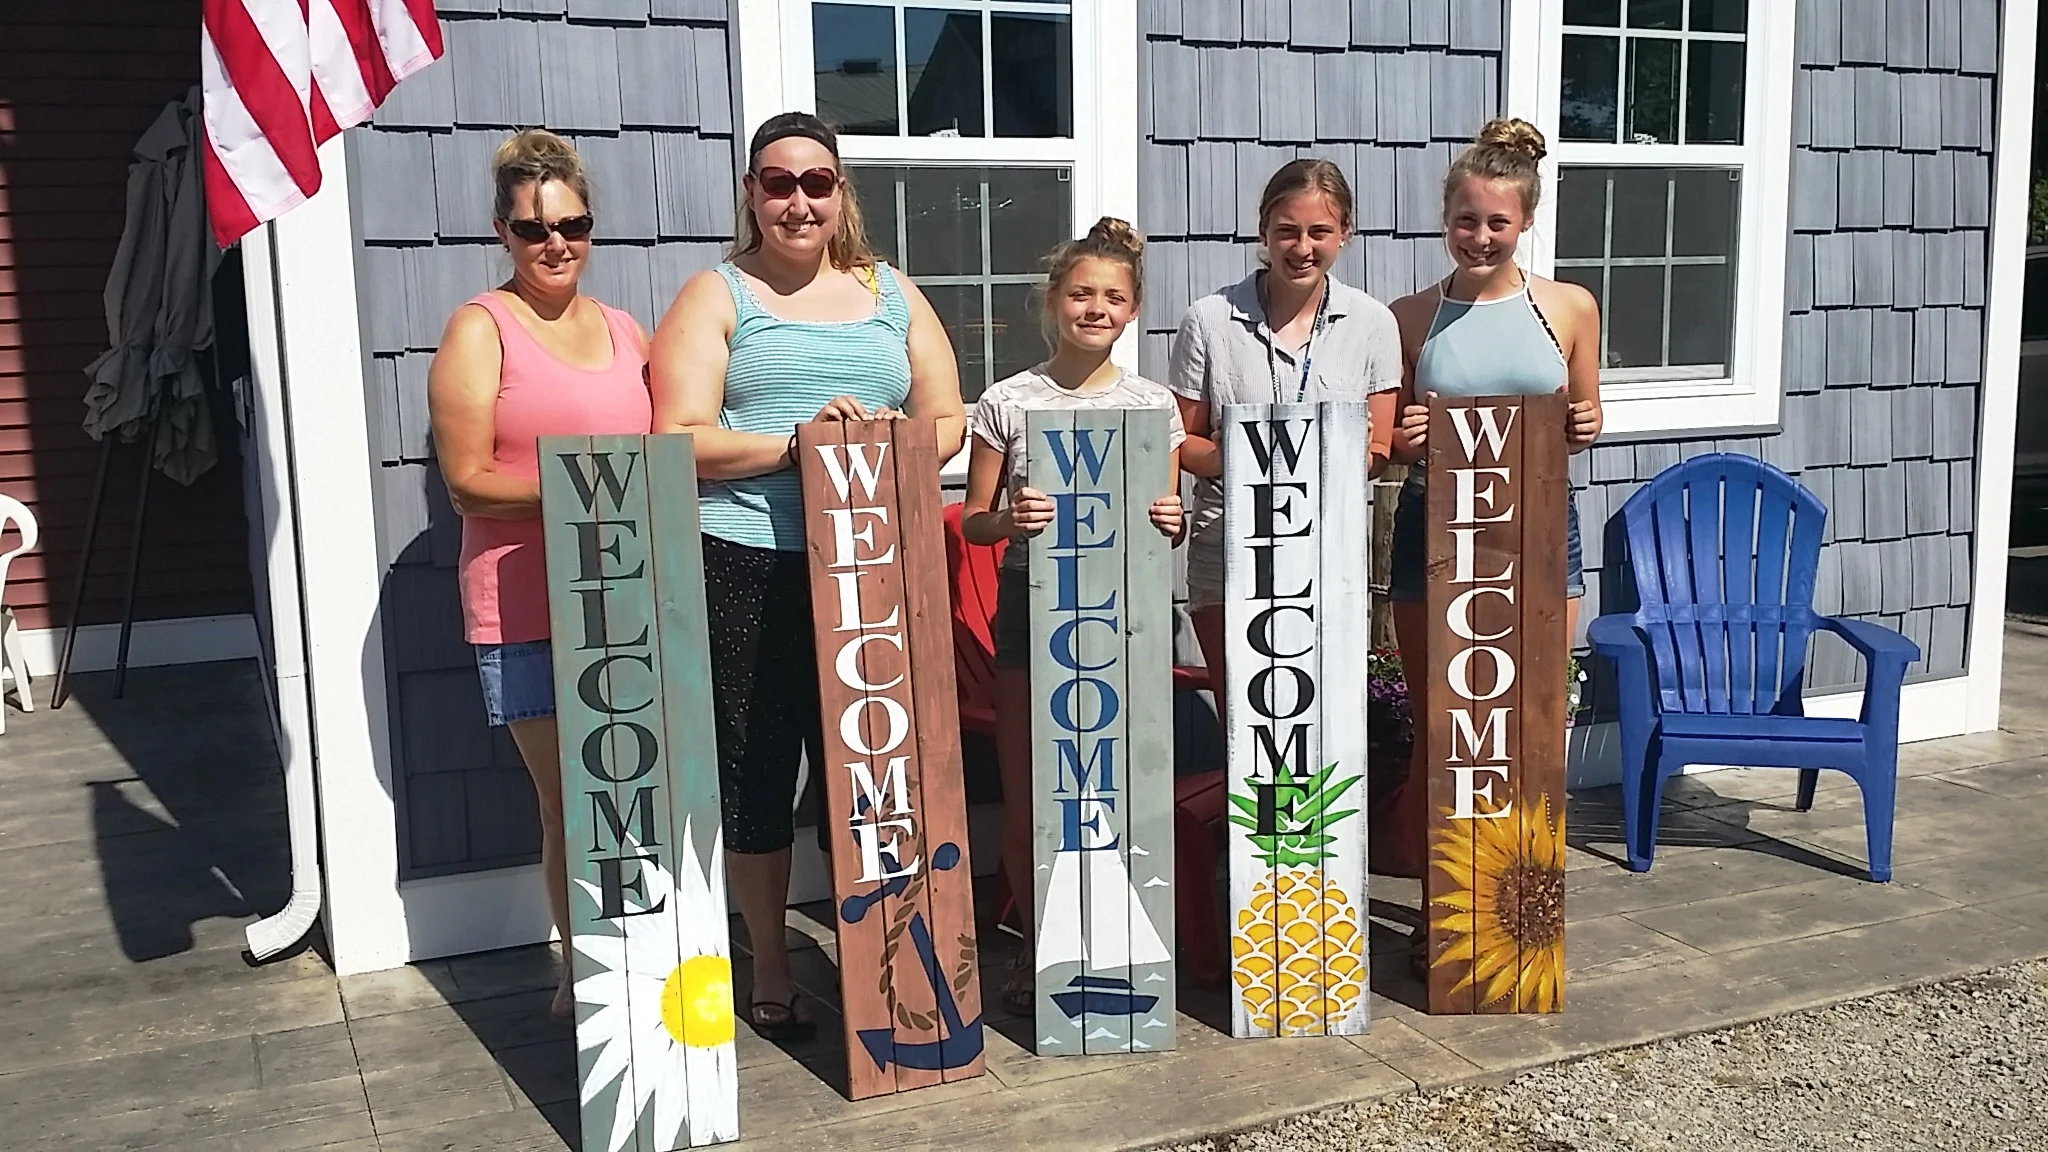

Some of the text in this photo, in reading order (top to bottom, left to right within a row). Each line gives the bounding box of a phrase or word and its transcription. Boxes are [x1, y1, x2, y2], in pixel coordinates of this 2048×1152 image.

[557, 451, 666, 921] WELCOME
[815, 442, 920, 885] WELCOME
[1042, 429, 1120, 853] WELCOME
[1238, 418, 1315, 837] WELCOME
[1445, 405, 1519, 820] WELCOME
